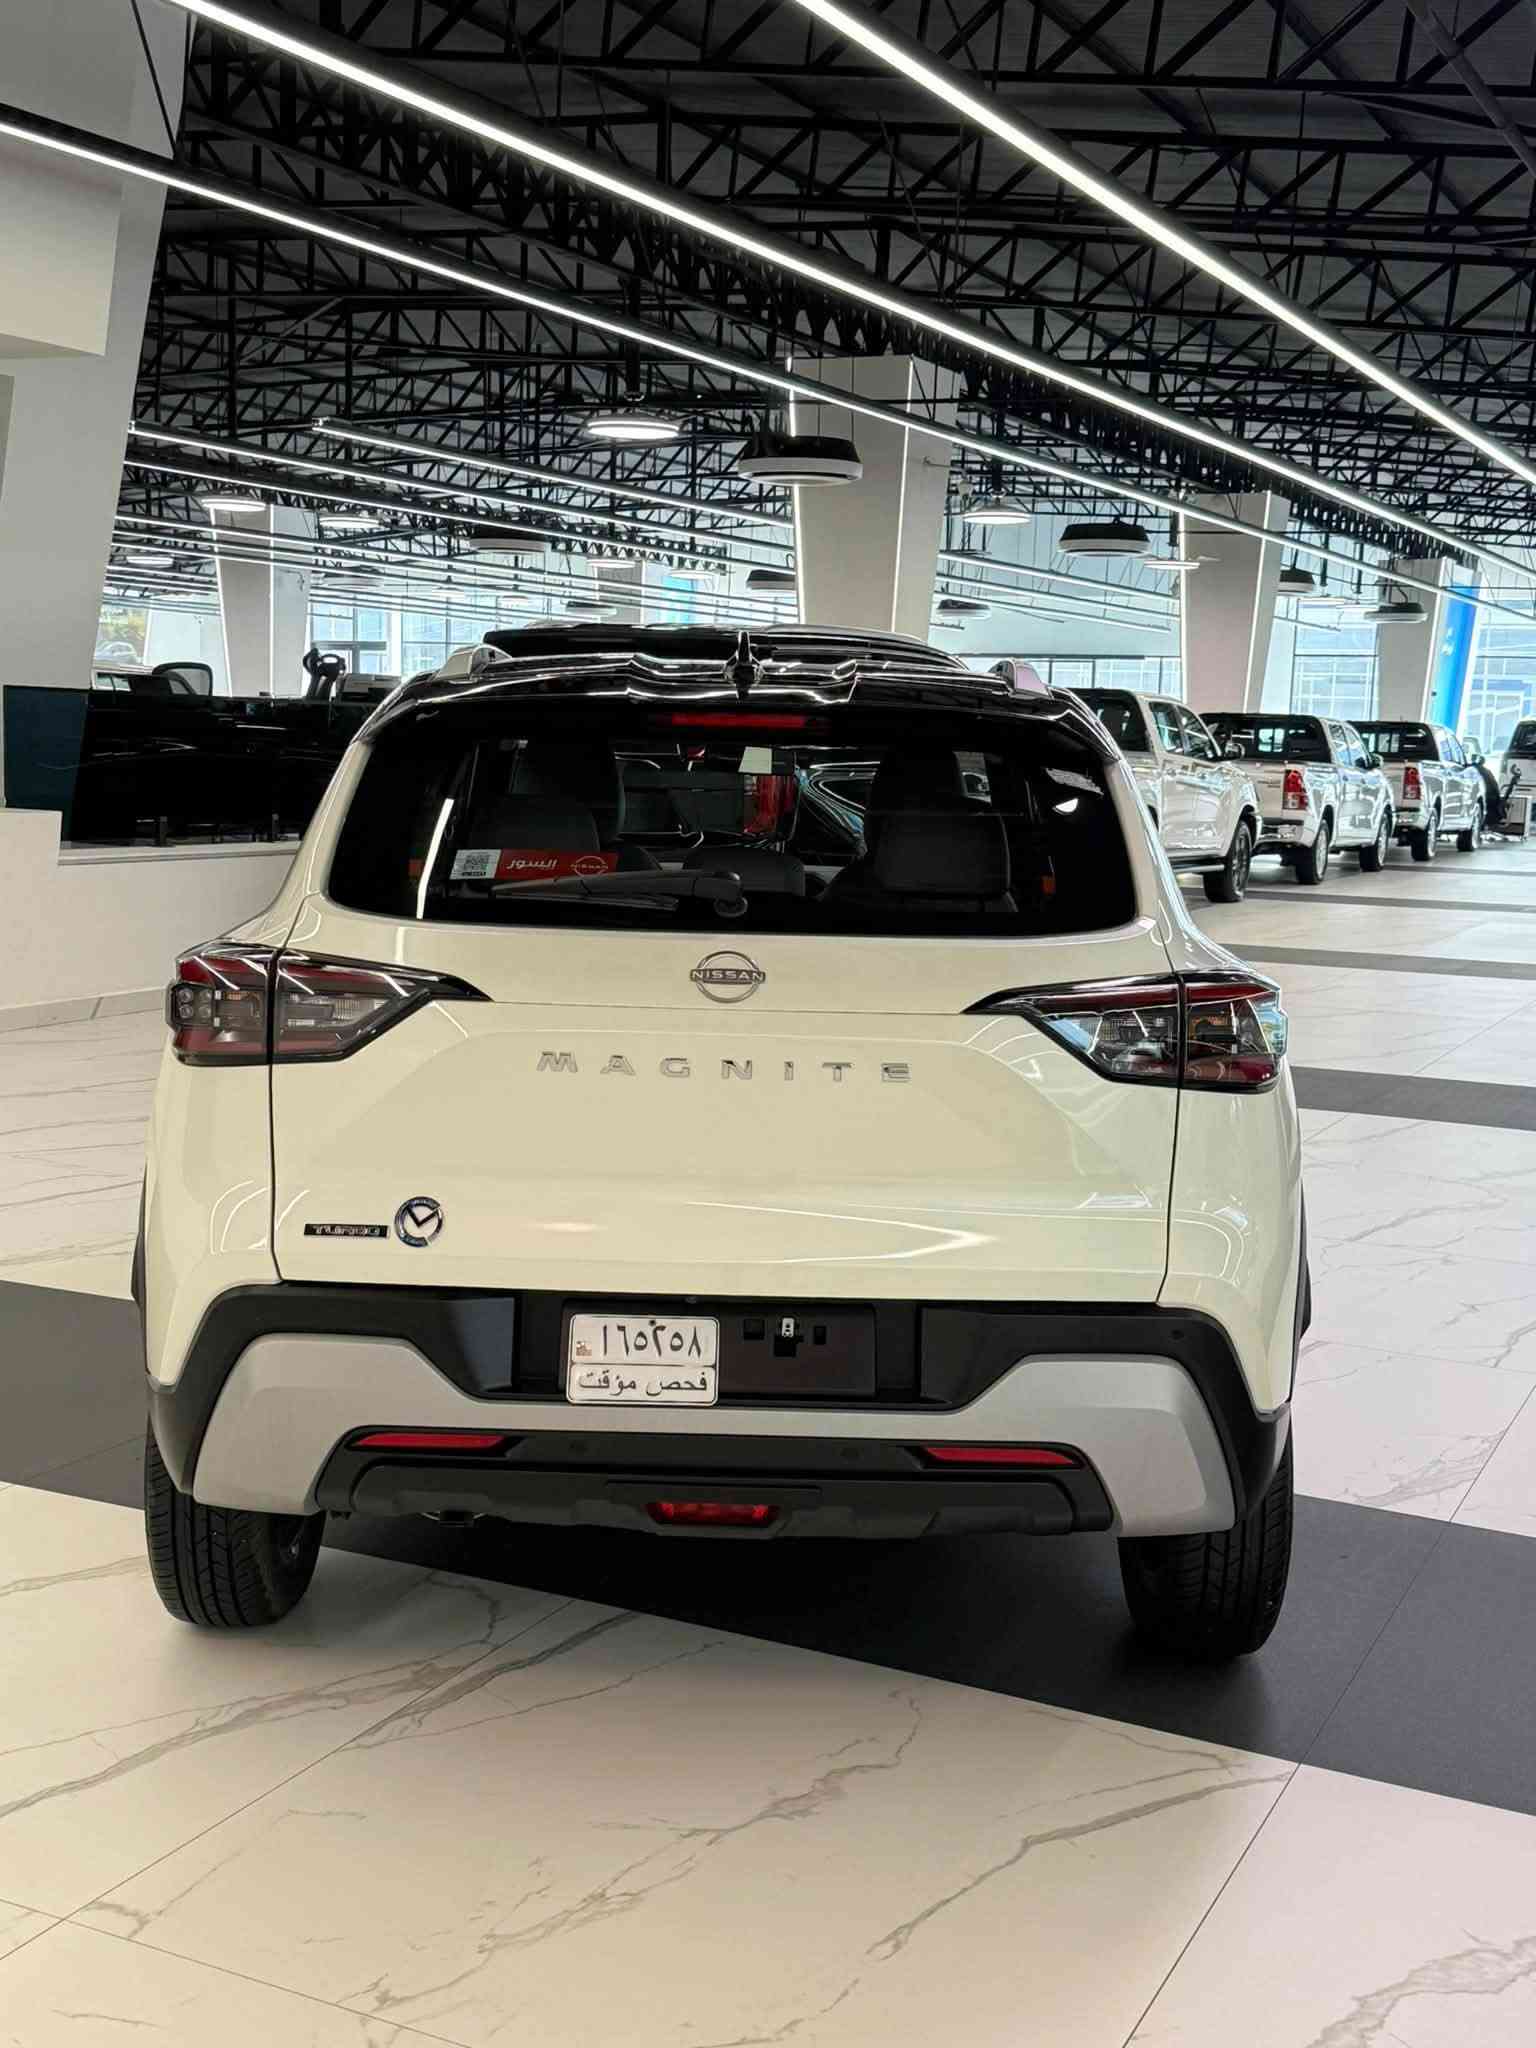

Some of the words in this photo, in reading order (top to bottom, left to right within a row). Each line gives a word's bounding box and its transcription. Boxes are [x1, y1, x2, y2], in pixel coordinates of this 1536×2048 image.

[690, 969, 765, 982] NISSAN
[536, 1050, 912, 1083] MAGNITE
[602, 1324, 702, 1357] ١٦٥٢٥٨
[578, 1369, 637, 1396] مؤقت
[646, 1371, 708, 1397] فحص
